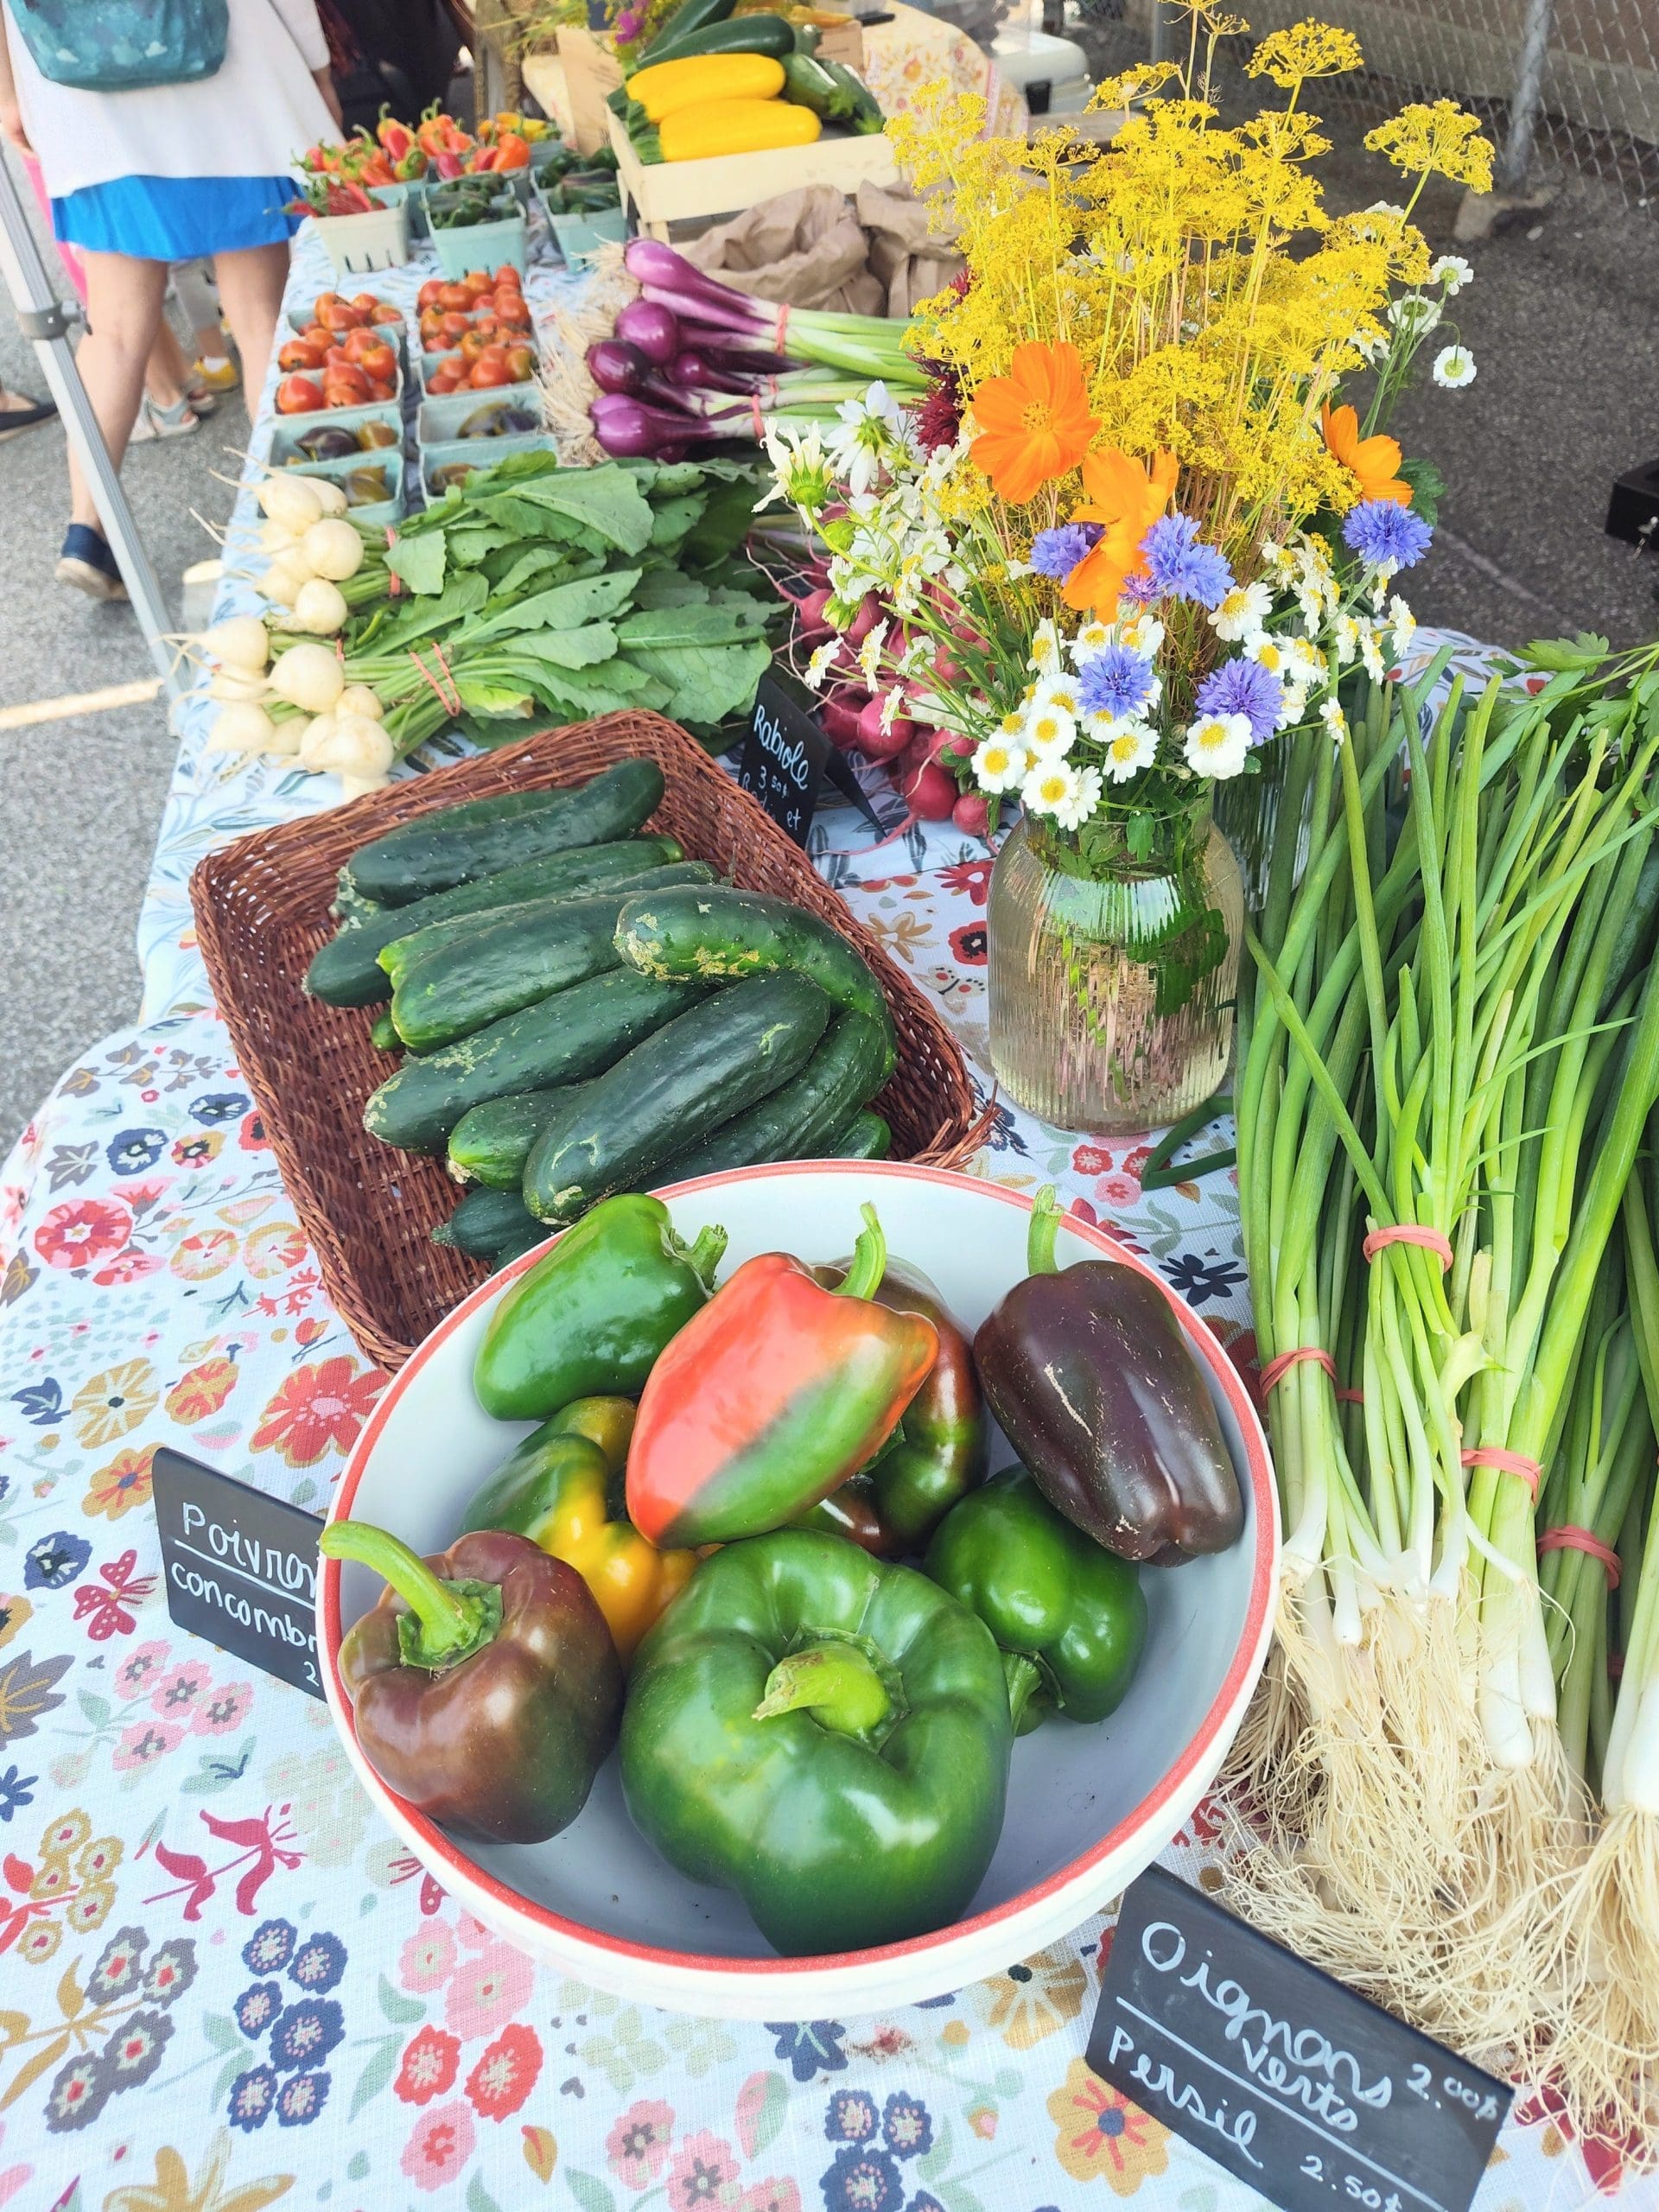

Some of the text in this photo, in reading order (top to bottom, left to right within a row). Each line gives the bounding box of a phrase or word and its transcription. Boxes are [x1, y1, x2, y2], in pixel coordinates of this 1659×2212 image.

[753, 704, 809, 790] Rabiole
[1141, 1921, 1392, 2109] Oignons
[1109, 2025, 1263, 2169] Persil
